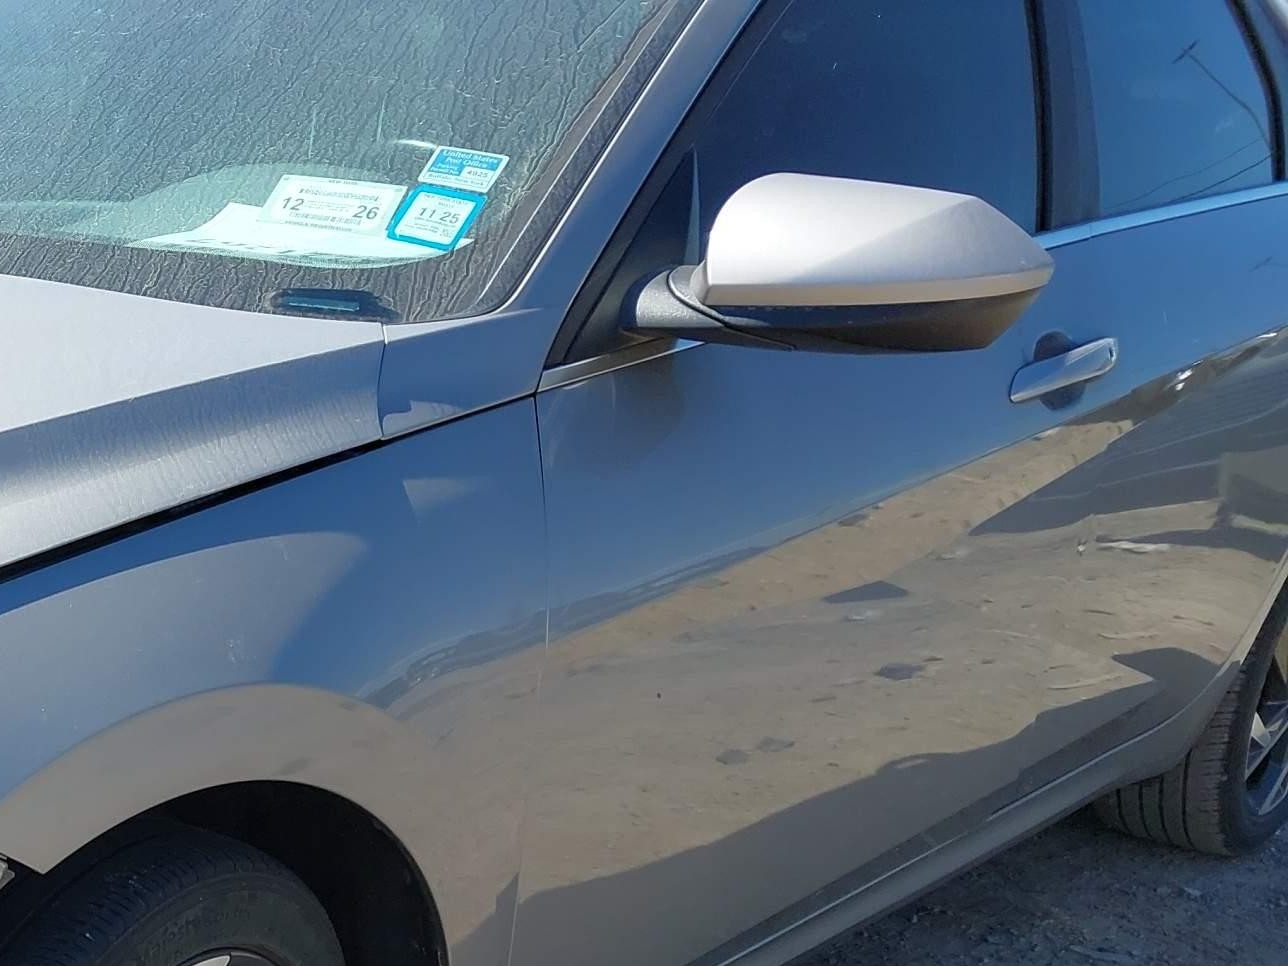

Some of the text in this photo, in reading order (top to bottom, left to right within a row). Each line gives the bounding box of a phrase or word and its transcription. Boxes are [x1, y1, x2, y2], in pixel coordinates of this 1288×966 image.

[442, 149, 472, 159] United
[463, 160, 488, 168] Office
[282, 196, 304, 211] 12
[352, 205, 380, 220] 26
[439, 211, 461, 224] 25
